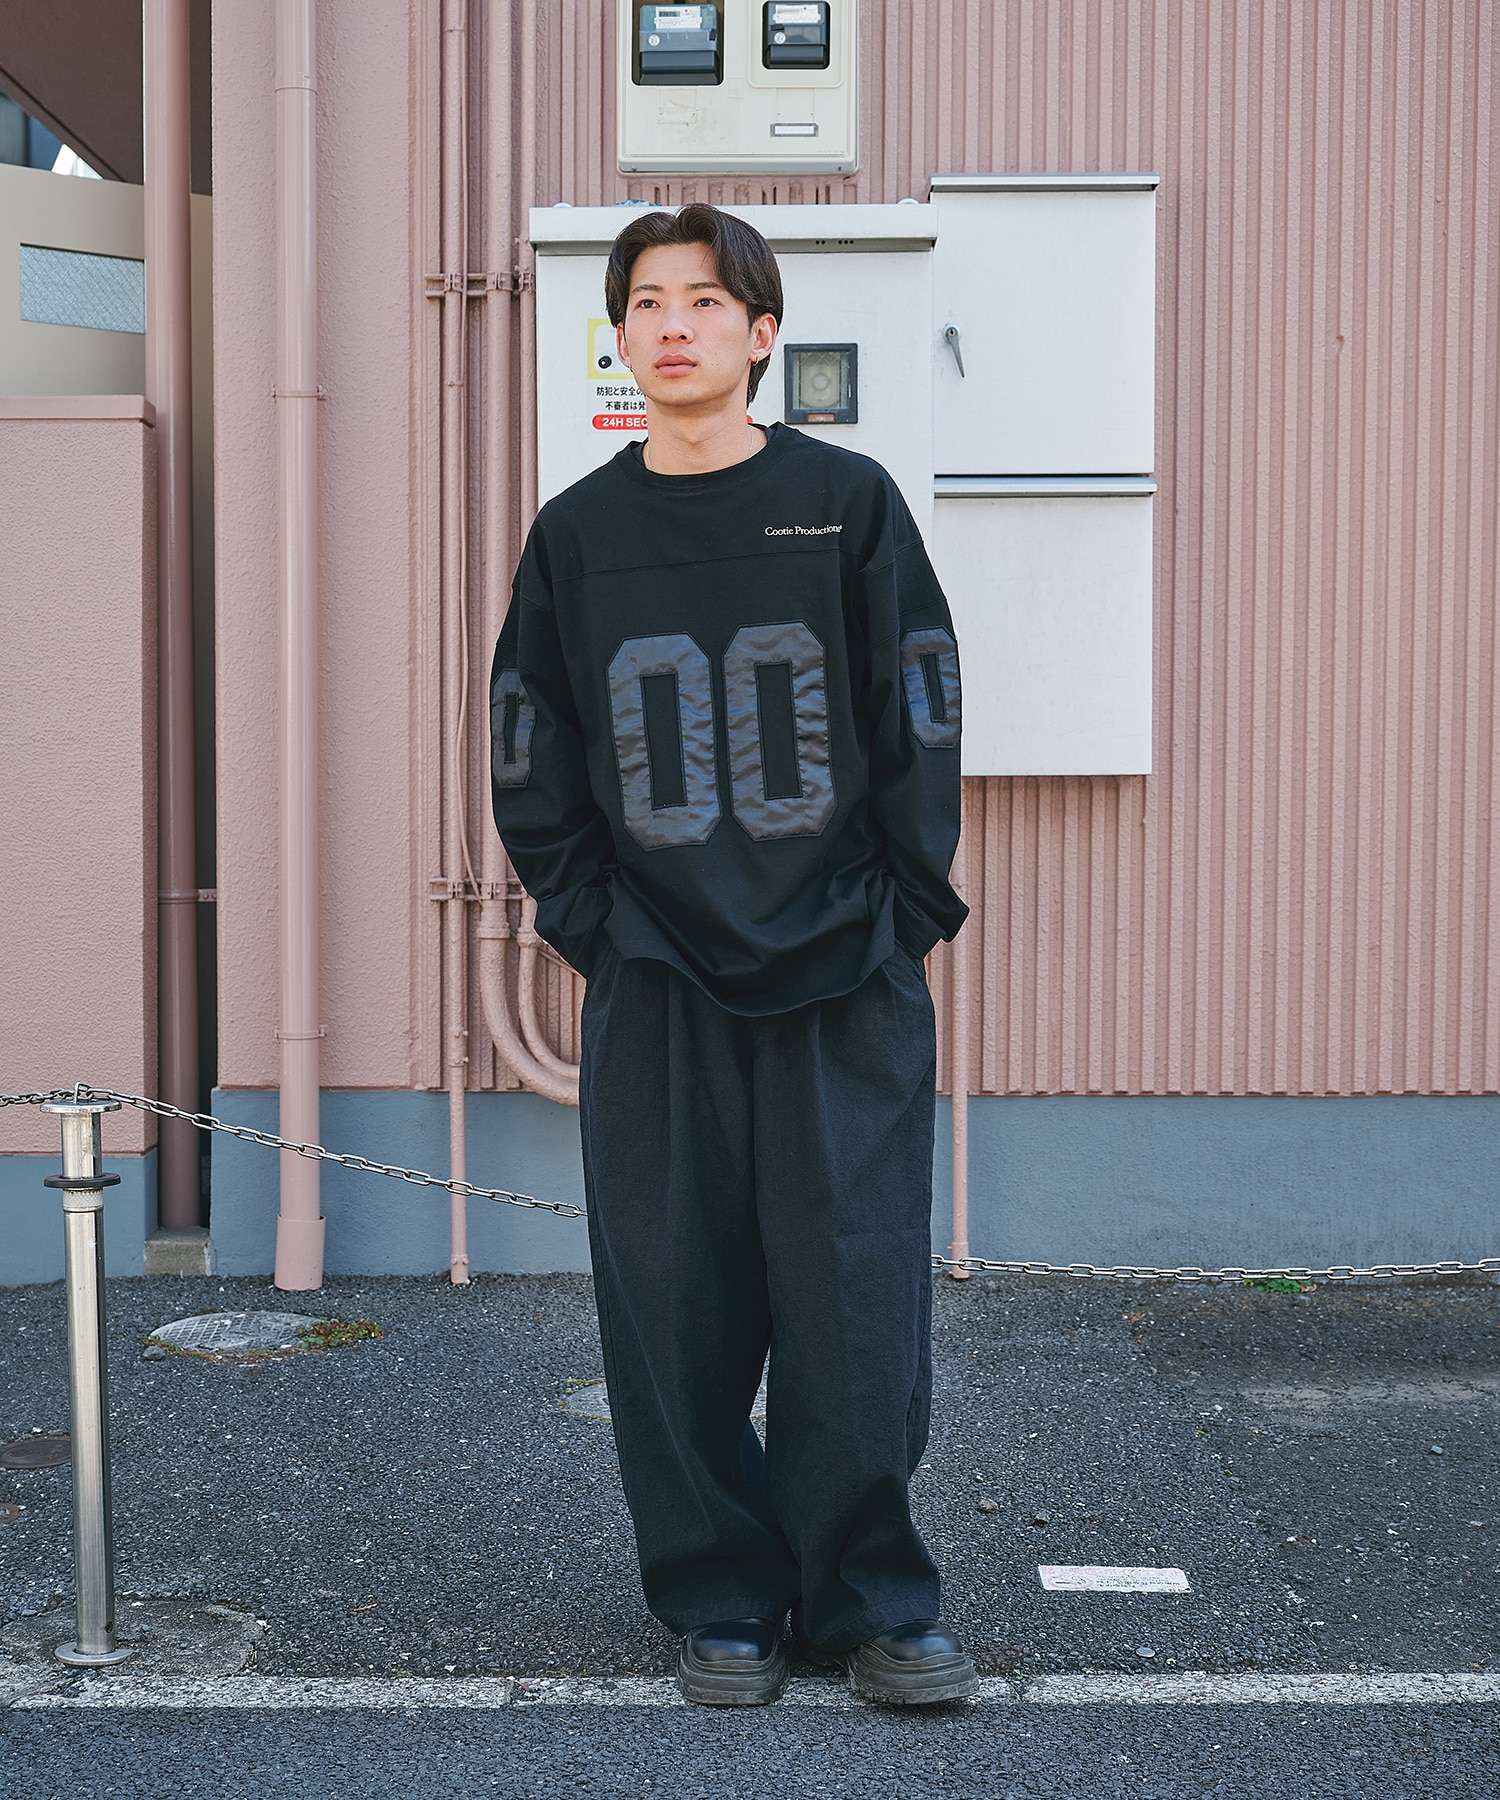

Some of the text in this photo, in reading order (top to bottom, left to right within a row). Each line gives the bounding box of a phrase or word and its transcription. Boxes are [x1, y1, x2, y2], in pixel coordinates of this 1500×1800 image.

[602, 417, 624, 427] 24H
[764, 526, 794, 536] Cootie
[606, 620, 837, 851] 00
